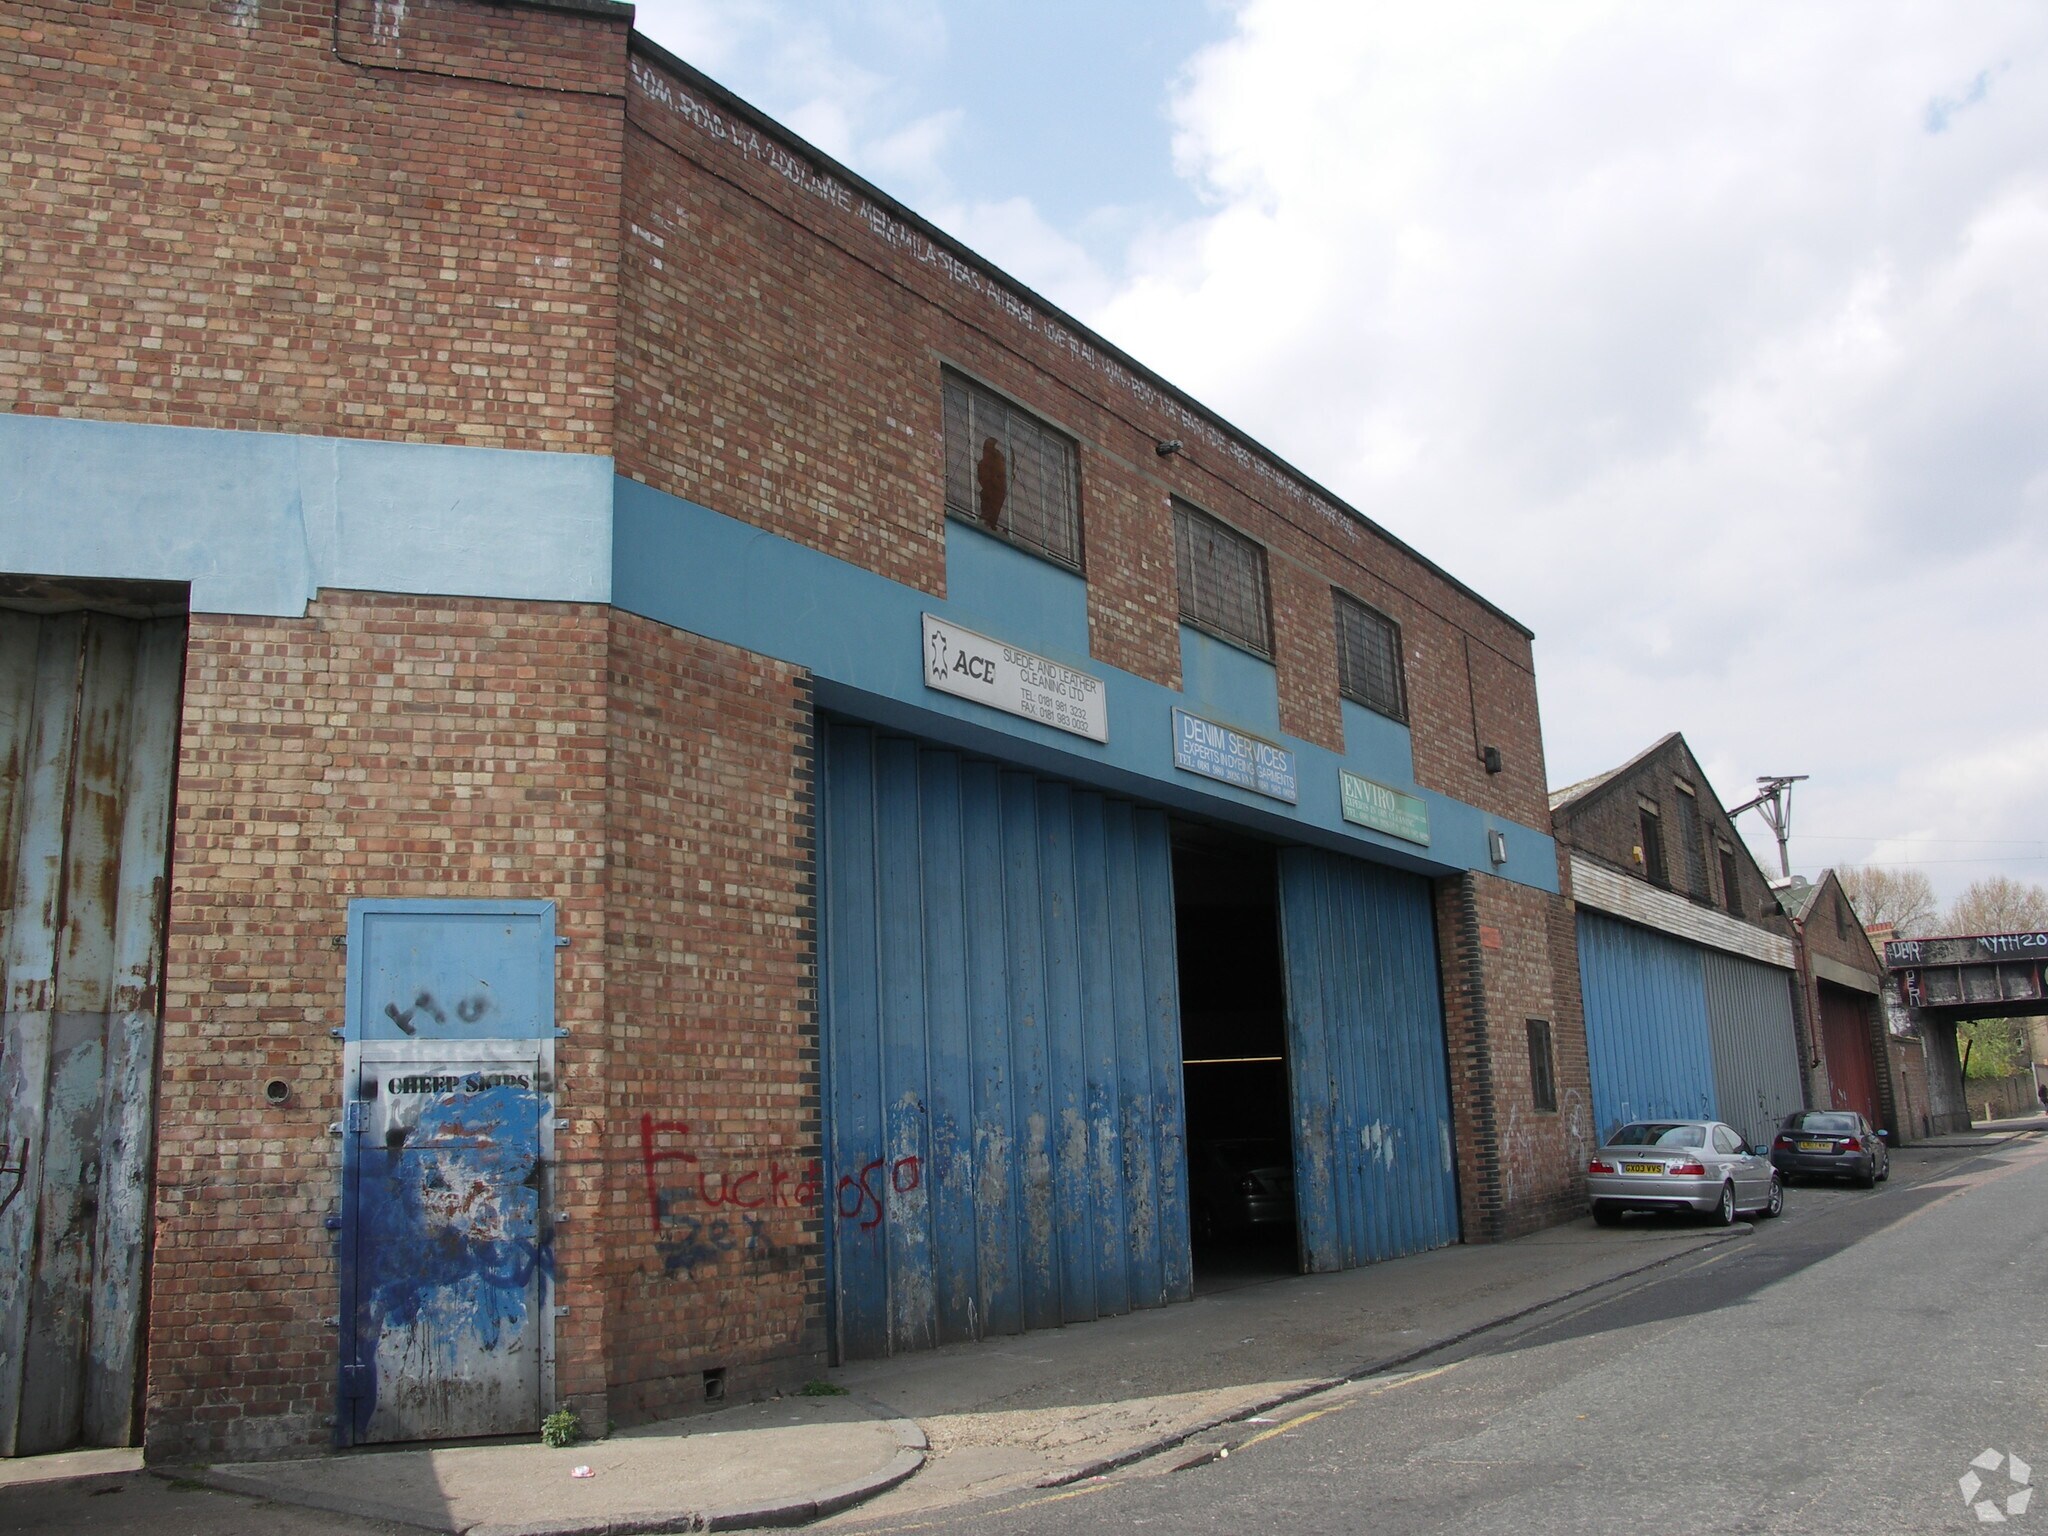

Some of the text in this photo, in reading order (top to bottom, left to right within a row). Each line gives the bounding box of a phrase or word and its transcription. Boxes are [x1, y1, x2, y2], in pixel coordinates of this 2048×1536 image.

[953, 650, 996, 685] ACE
[1003, 649, 1097, 694] SUEDE AND LEATHER
[1020, 668, 1085, 702] CLEANING LTD
[1038, 694, 1053, 708] 0181
[1056, 699, 1068, 711] 981
[1070, 704, 1087, 720] 3232
[1040, 707, 1055, 721] 0181
[1057, 712, 1070, 725] 983
[1072, 717, 1089, 733] 0032
[1184, 716, 1287, 772] DENIM SERVICES
[1183, 739, 1220, 763] EXPERTS
[1228, 755, 1255, 775] DYEING
[1257, 765, 1295, 789] GARMENTS
[1344, 774, 1395, 812] ENVIRO
[1625, 1164, 1662, 1174] GX03 VVS
